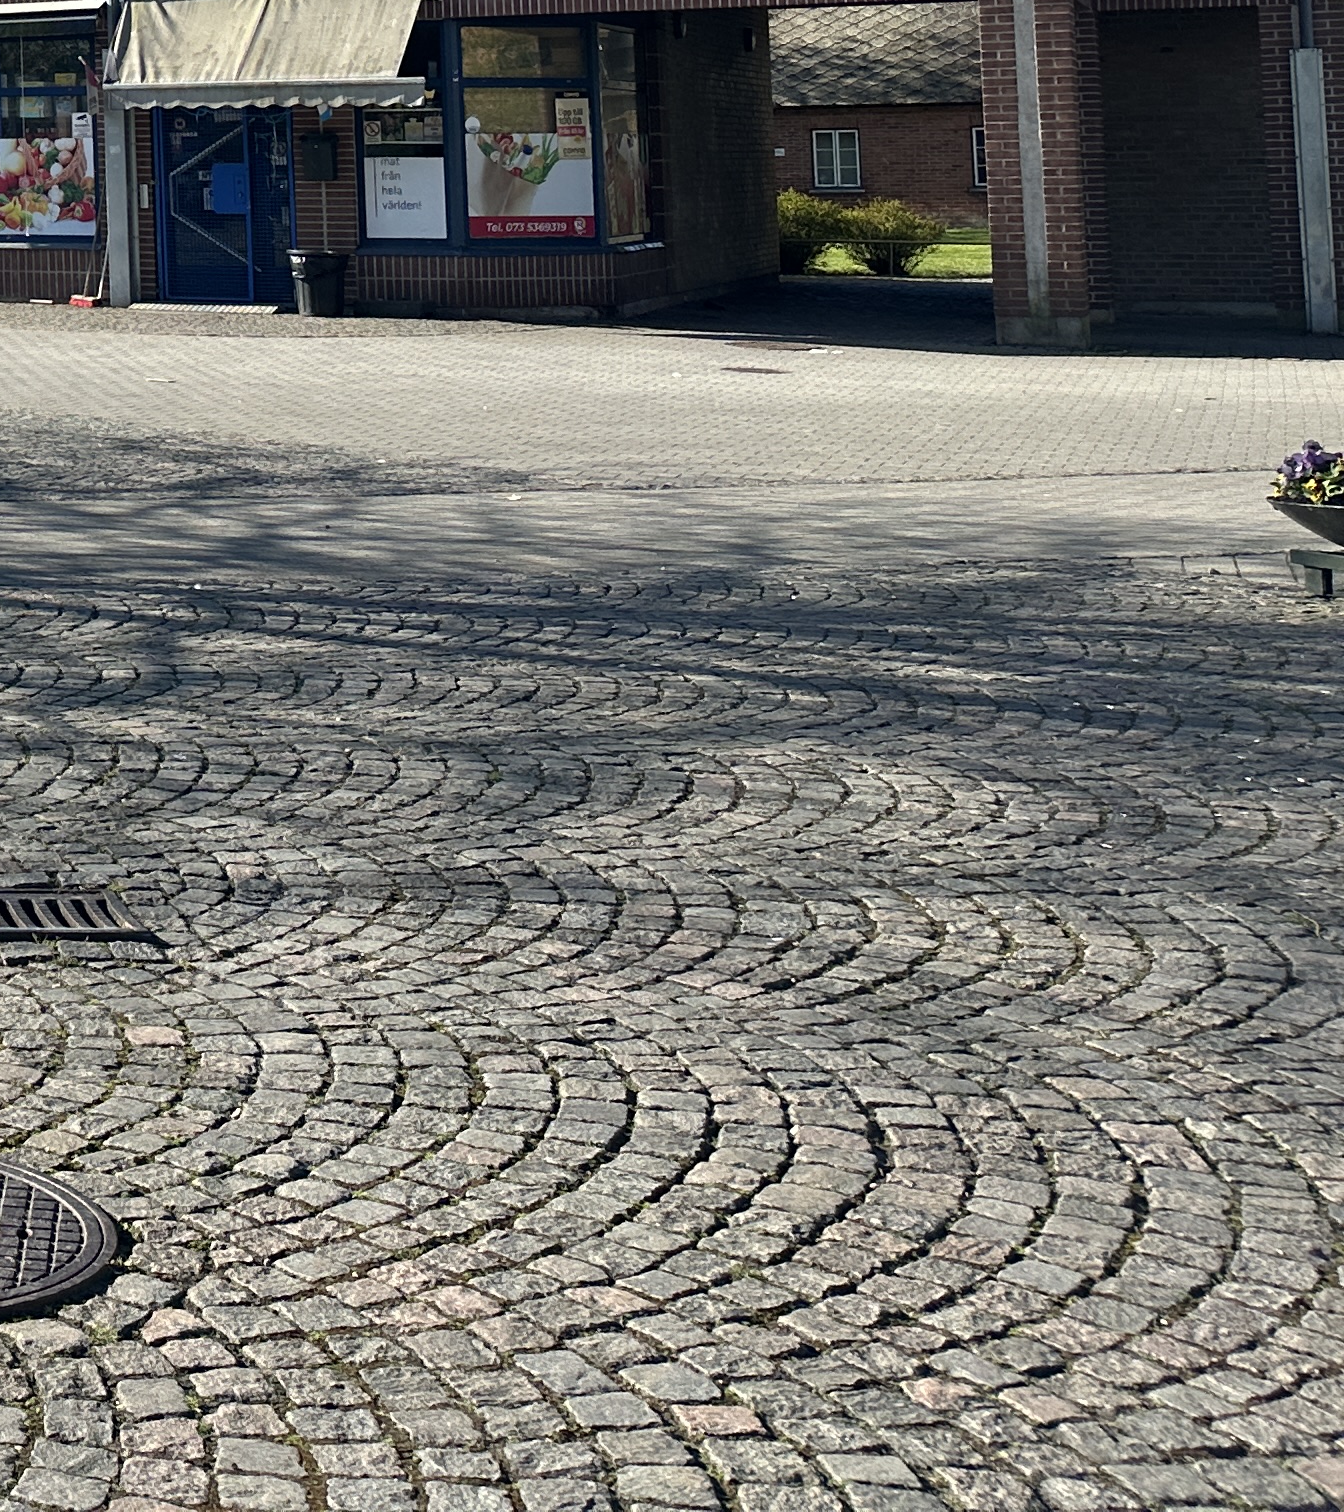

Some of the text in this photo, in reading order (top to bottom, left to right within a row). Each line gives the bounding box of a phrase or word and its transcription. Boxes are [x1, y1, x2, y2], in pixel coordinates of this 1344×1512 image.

[381, 171, 401, 181] från
[382, 185, 403, 195] hela
[486, 222, 567, 232] Tel. 073 5369319
